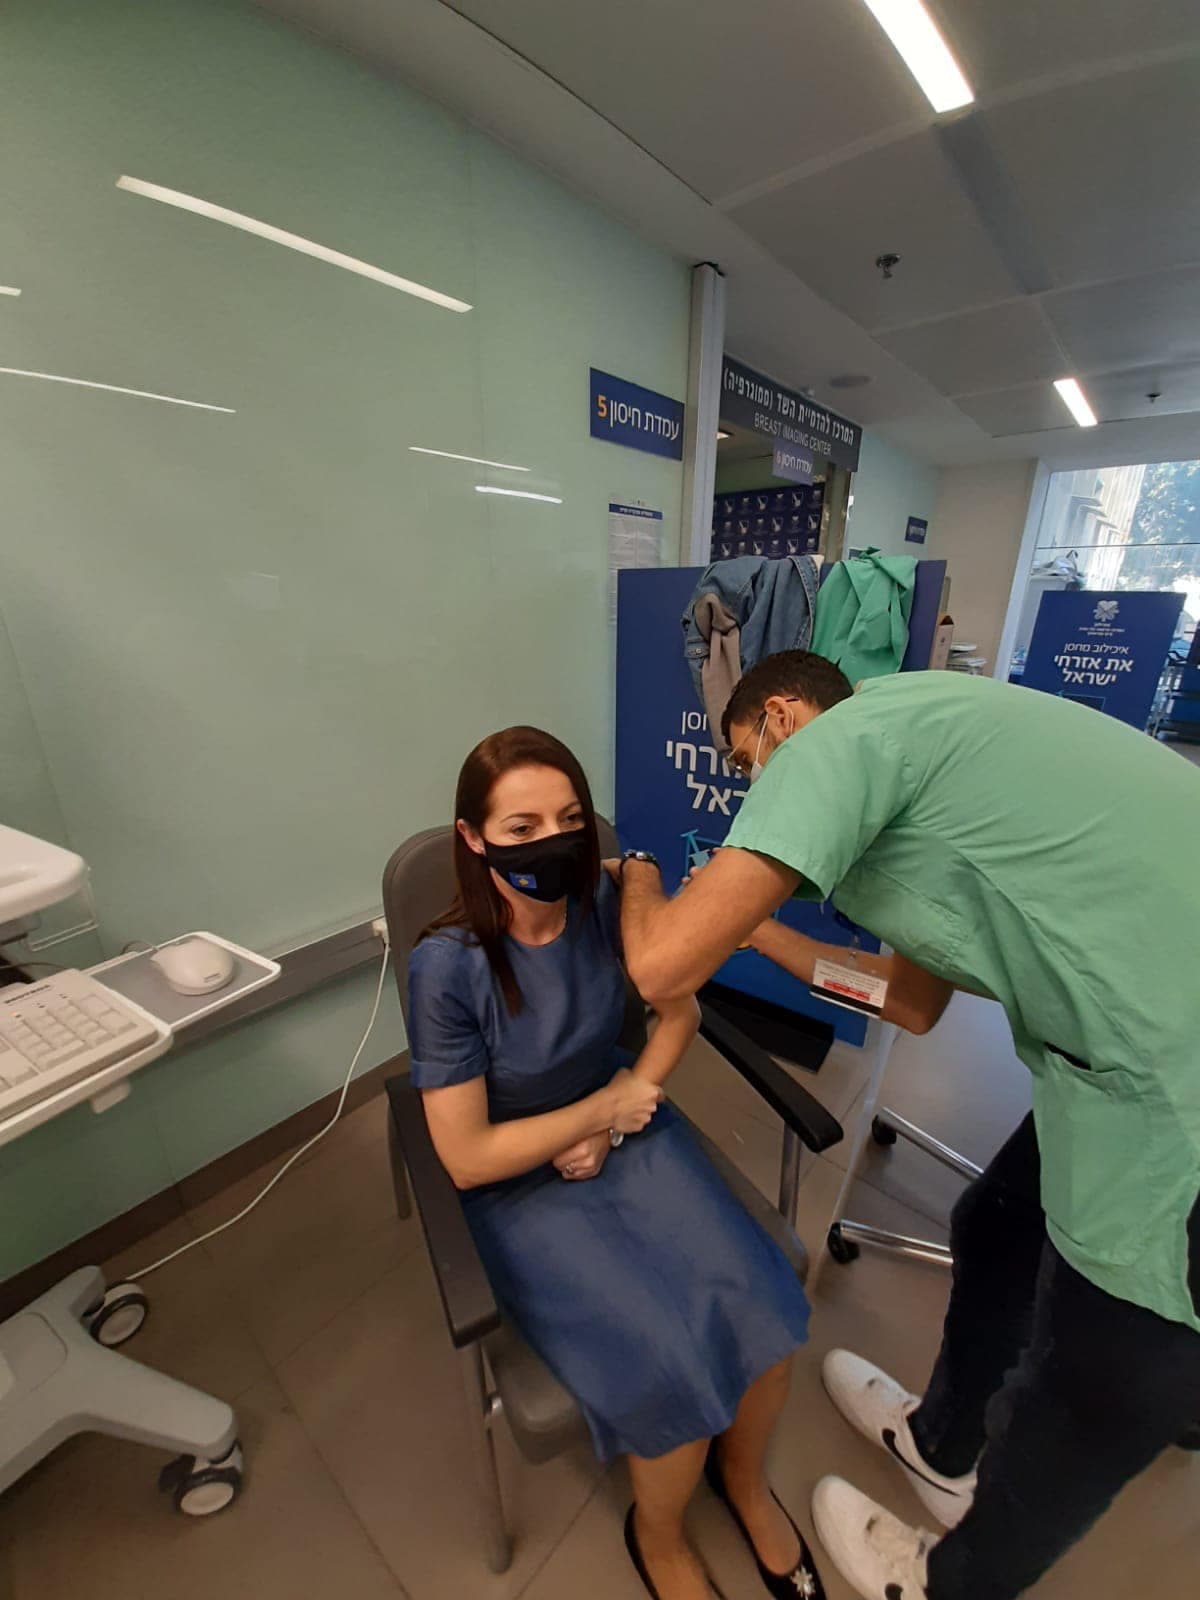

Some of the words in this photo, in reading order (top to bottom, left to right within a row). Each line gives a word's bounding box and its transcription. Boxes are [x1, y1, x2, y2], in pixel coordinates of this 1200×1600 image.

[597, 394, 608, 418] 5
[610, 399, 641, 428] חיסון
[777, 392, 796, 419] השד
[643, 411, 680, 441] עמדת
[754, 412, 782, 437] BREAST
[782, 424, 809, 447] IMAGING
[809, 436, 832, 455] CENTER
[831, 420, 854, 446] המרכז
[1063, 643, 1090, 653] מחסן
[1054, 655, 1103, 670] אזרחי
[1104, 658, 1134, 672] את
[1062, 667, 1117, 686] ישראל
